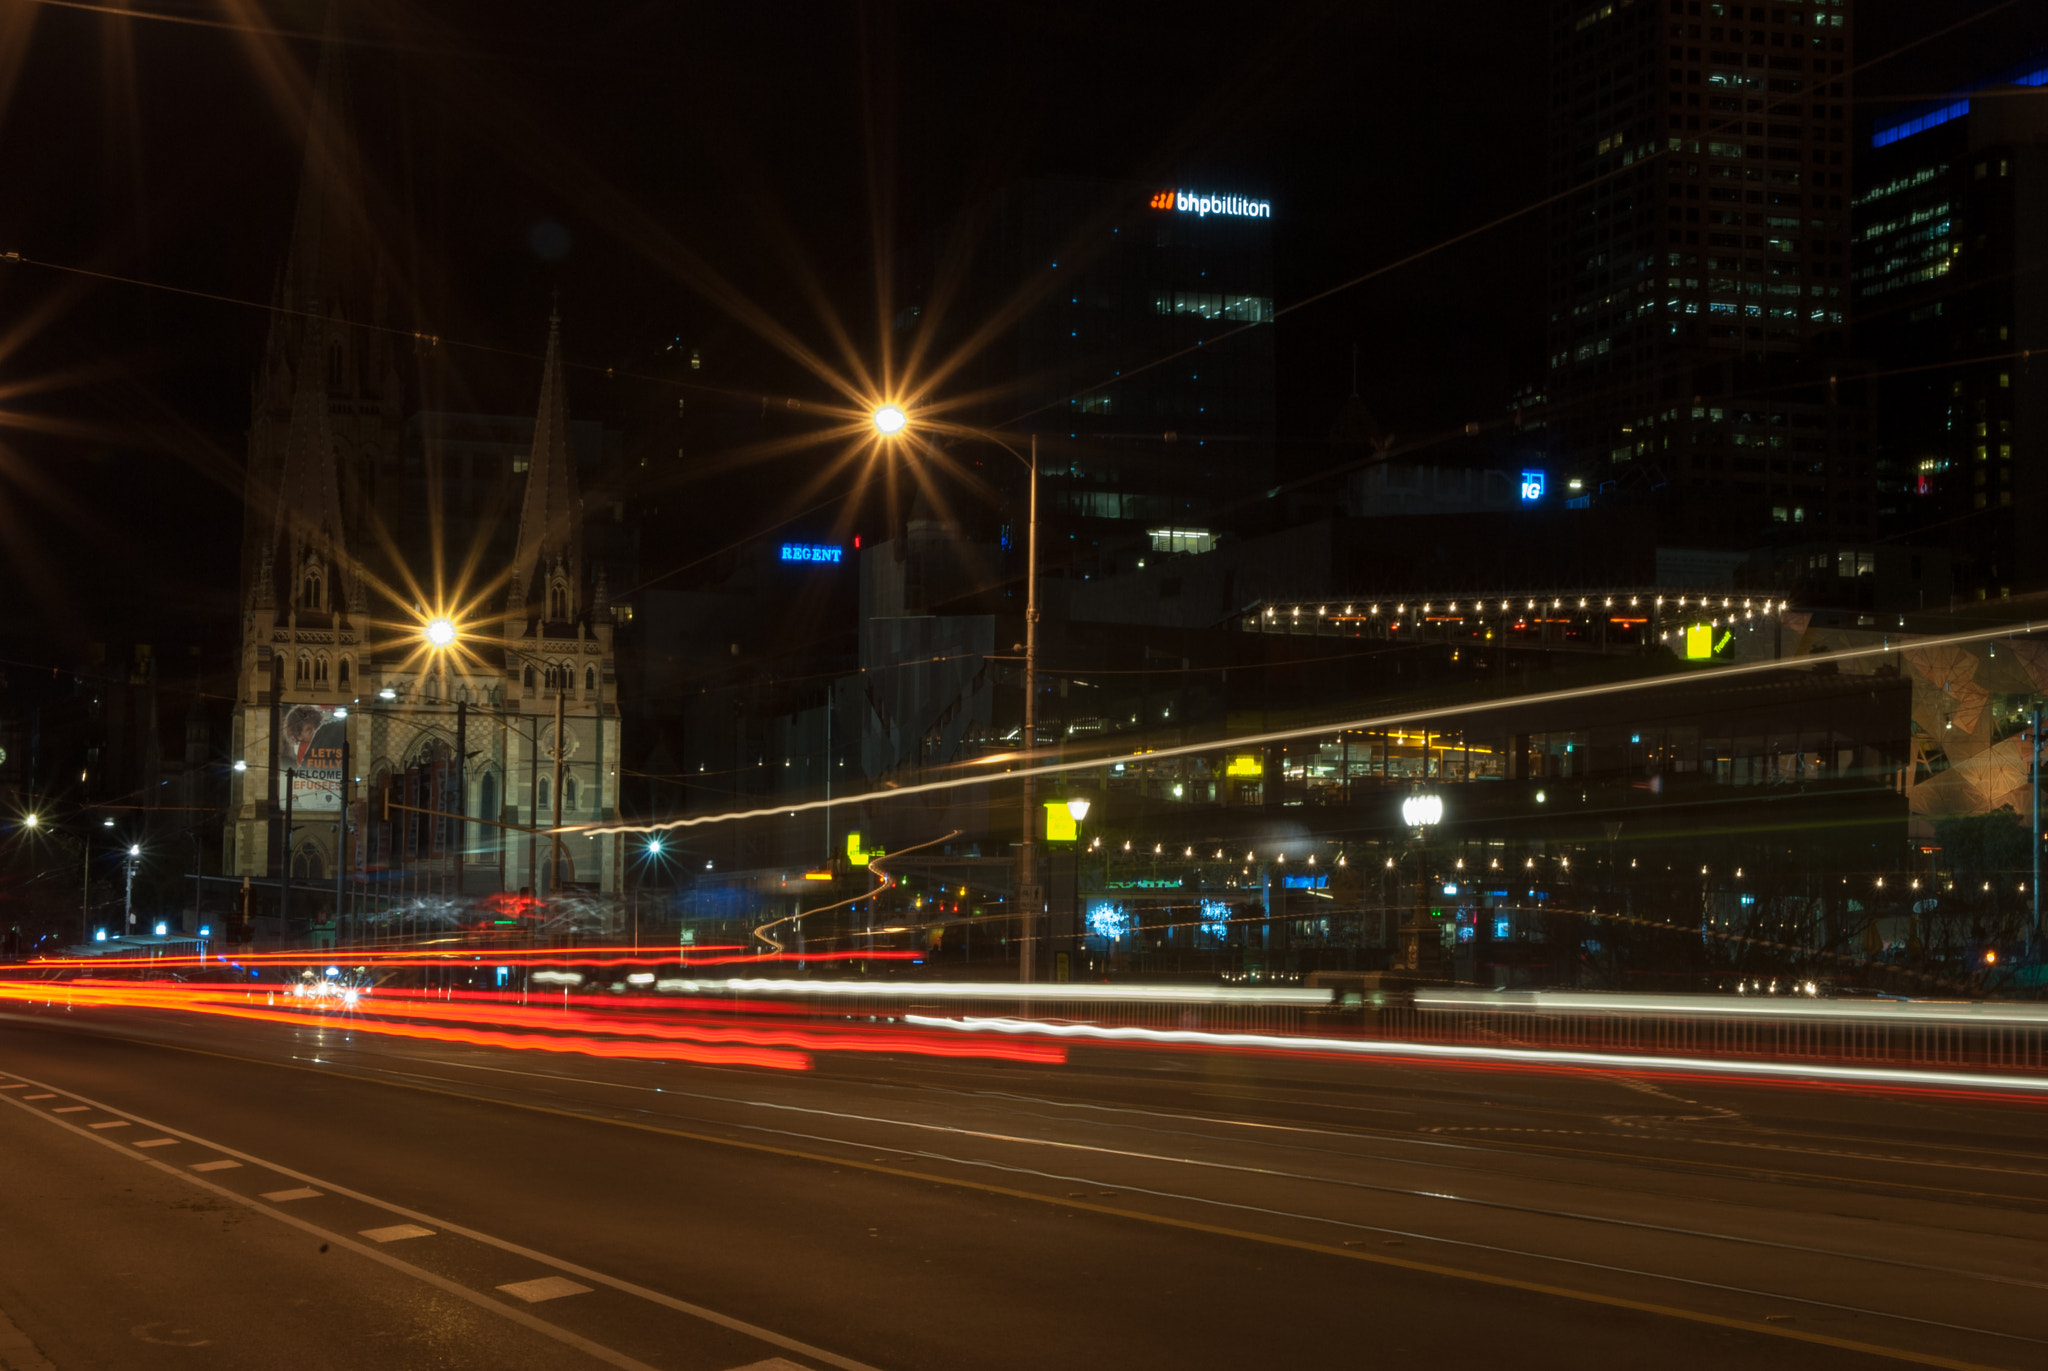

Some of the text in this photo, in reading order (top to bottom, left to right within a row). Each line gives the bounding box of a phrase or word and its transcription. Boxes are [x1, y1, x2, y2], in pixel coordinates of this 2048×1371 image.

[1177, 192, 1271, 218] bhpbilliton
[781, 546, 842, 563] REGENT
[311, 747, 343, 758] LET'S
[306, 758, 343, 769] FULLY
[293, 780, 343, 791] EFUGEES
